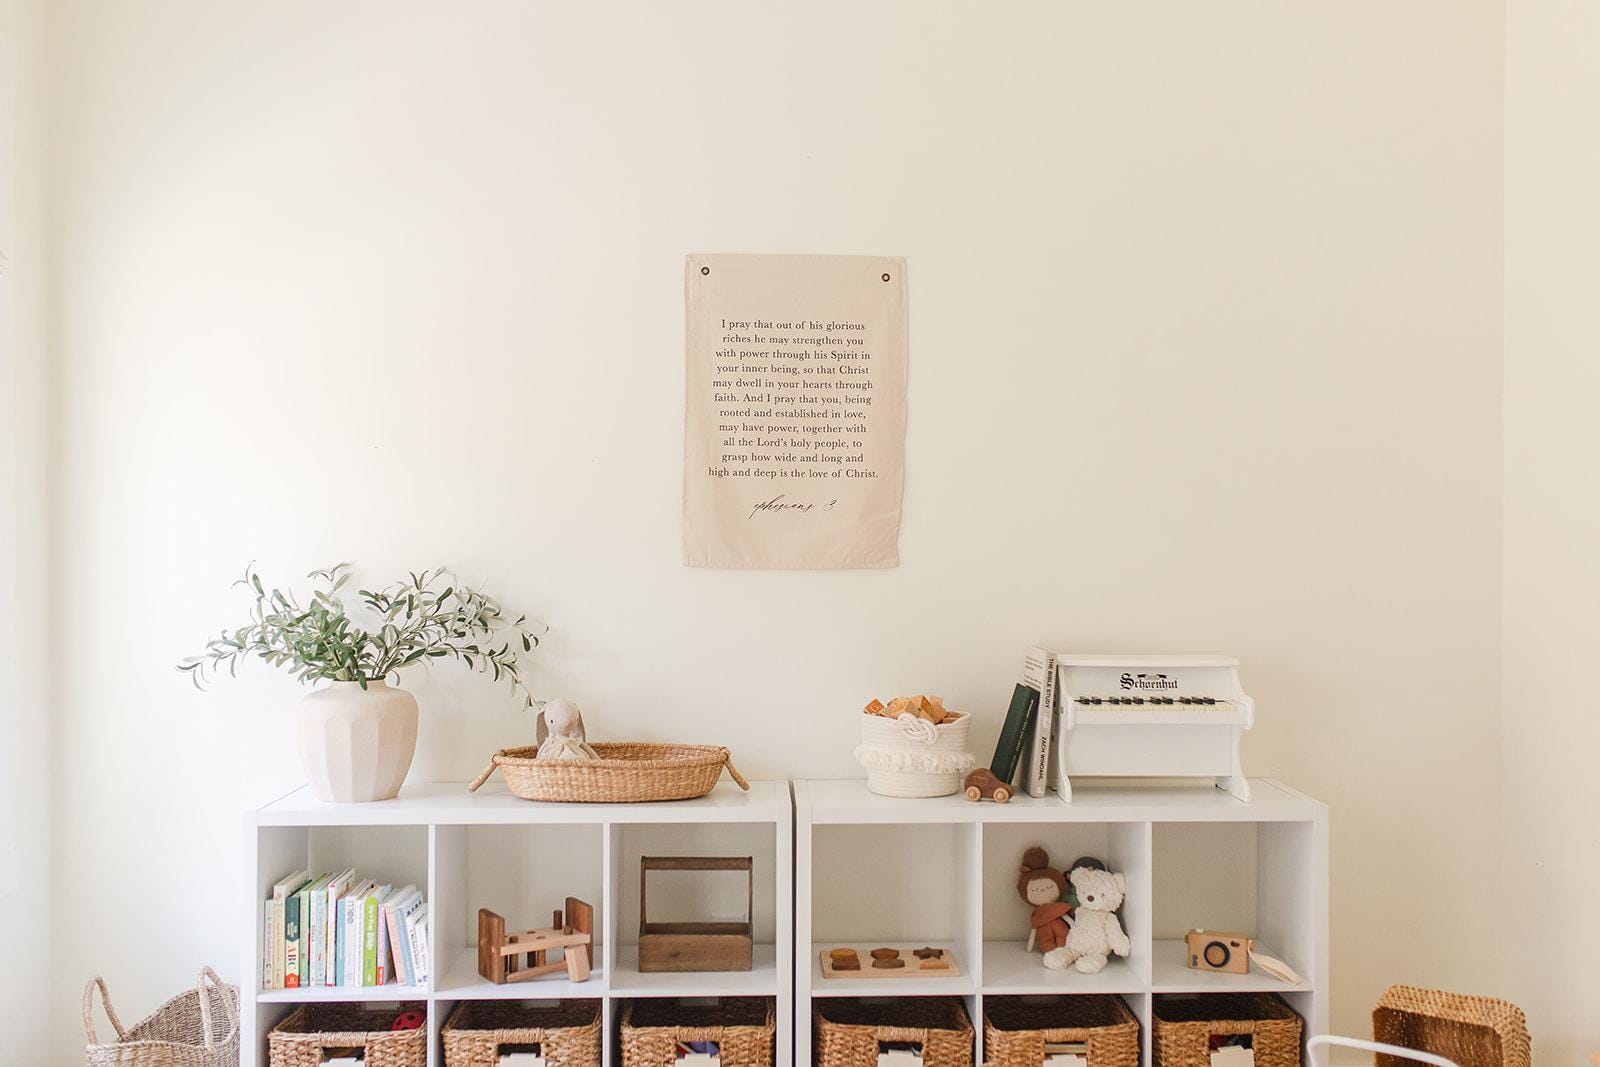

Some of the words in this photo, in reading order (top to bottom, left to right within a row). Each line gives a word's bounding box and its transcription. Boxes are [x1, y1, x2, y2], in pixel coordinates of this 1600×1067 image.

[722, 319, 726, 328] I
[729, 322, 751, 331] pray
[754, 320, 773, 329] that
[795, 321, 806, 329] of
[809, 321, 823, 330] his
[825, 321, 865, 332] glorious
[723, 334, 752, 343] riches
[754, 334, 766, 343] he
[769, 337, 789, 346] may
[793, 336, 843, 347] strengthen
[846, 339, 863, 347] you
[716, 348, 736, 357] with
[739, 351, 770, 360] power
[773, 349, 810, 361] through
[814, 350, 829, 359] his
[830, 350, 859, 362] Spirit
[861, 351, 870, 359] in
[717, 366, 739, 375] your
[742, 363, 768, 373] inner
[771, 364, 800, 376] being,
[817, 365, 836, 374] that
[839, 365, 869, 374] Christ
[713, 381, 733, 389] may
[736, 378, 761, 387] dwell
[765, 379, 774, 388] in
[778, 382, 800, 390] your
[803, 380, 832, 389] hearts
[835, 380, 873, 391] through
[714, 393, 739, 402] faith.
[743, 393, 763, 402] And
[767, 393, 770, 402] I
[774, 396, 796, 405] pray
[799, 394, 818, 403] that
[820, 397, 841, 406] you,
[845, 395, 872, 406] being
[720, 408, 750, 417] rooted
[753, 408, 772, 417] and
[775, 409, 828, 418] established
[832, 409, 841, 418] in
[844, 409, 866, 419] love,
[719, 425, 739, 434] may
[742, 422, 764, 432] have
[768, 426, 799, 434] power,
[802, 424, 843, 435] together
[846, 424, 866, 433] with
[722, 437, 735, 446] all
[738, 437, 753, 446] the
[790, 438, 811, 450] holy
[814, 439, 849, 450] people,
[722, 454, 748, 463] grasp
[751, 452, 771, 461] how
[774, 453, 797, 462] wide
[800, 453, 818, 462] and
[821, 453, 842, 465] long
[846, 453, 863, 462] and
[708, 467, 729, 479] high
[732, 468, 751, 477] and
[754, 468, 777, 480] deep
[780, 468, 789, 477] is
[791, 469, 806, 478] the
[809, 469, 828, 478] love
[831, 469, 842, 478] of
[846, 469, 878, 478] Christ.
[823, 499, 838, 512] 3
[287, 946, 298, 970] ABC
